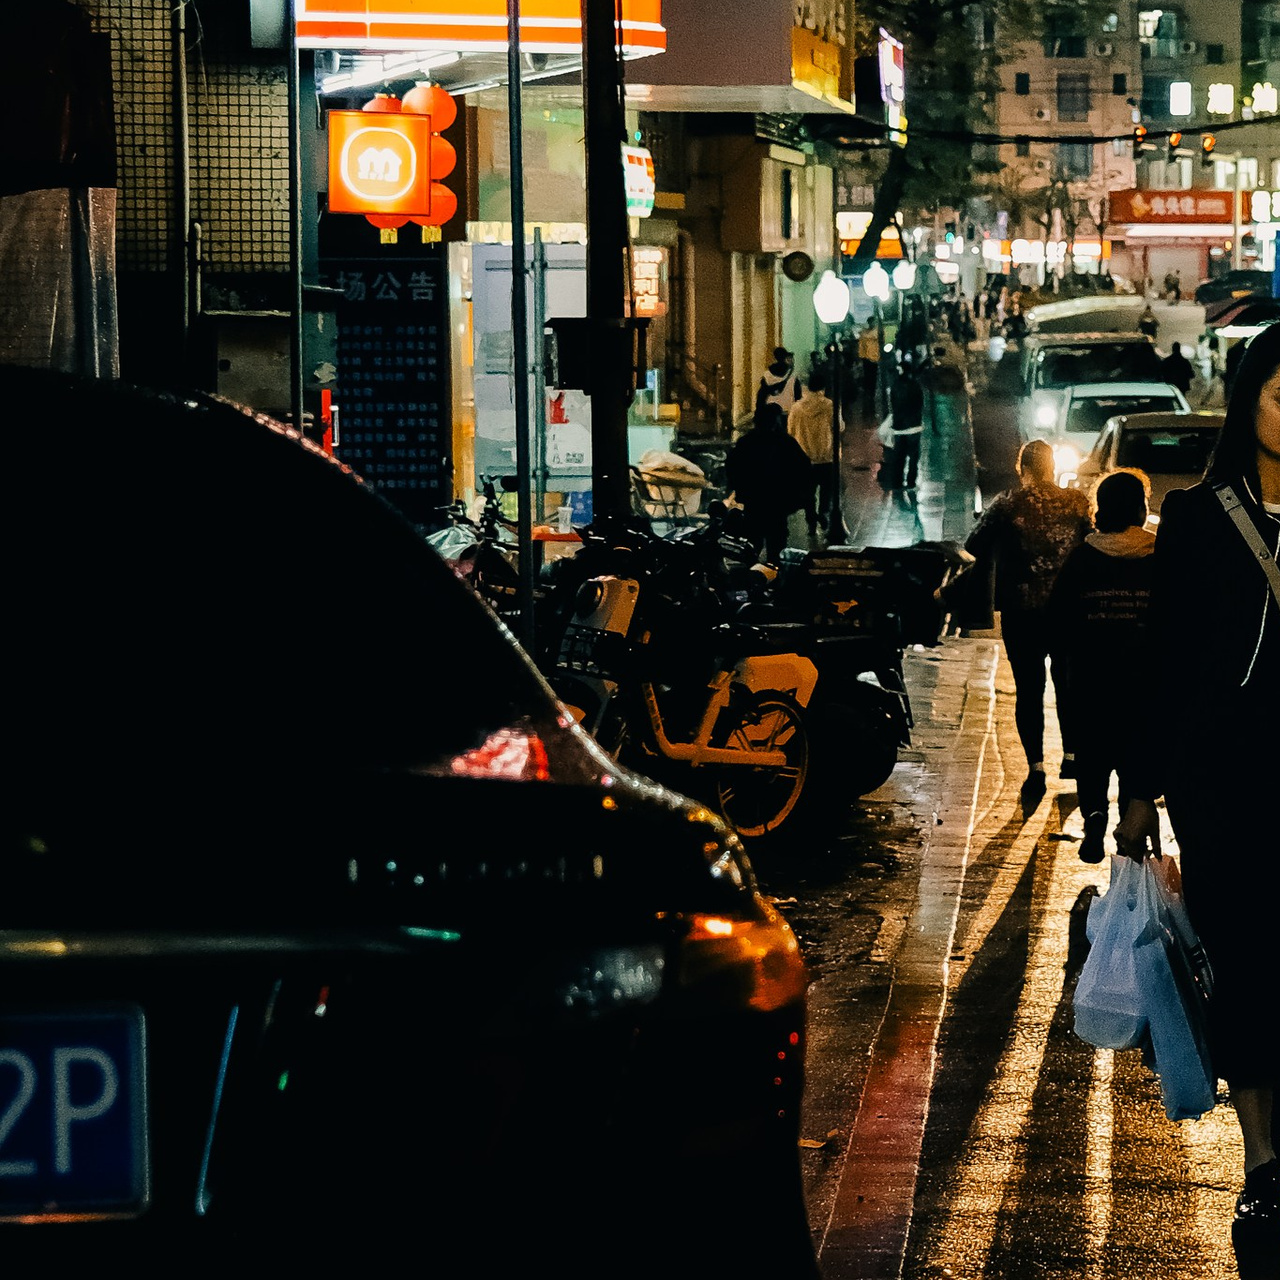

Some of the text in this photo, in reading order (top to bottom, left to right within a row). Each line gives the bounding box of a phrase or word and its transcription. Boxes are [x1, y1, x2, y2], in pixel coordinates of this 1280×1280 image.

[318, 270, 438, 301] 场公告
[0, 1047, 118, 1175] 2P
